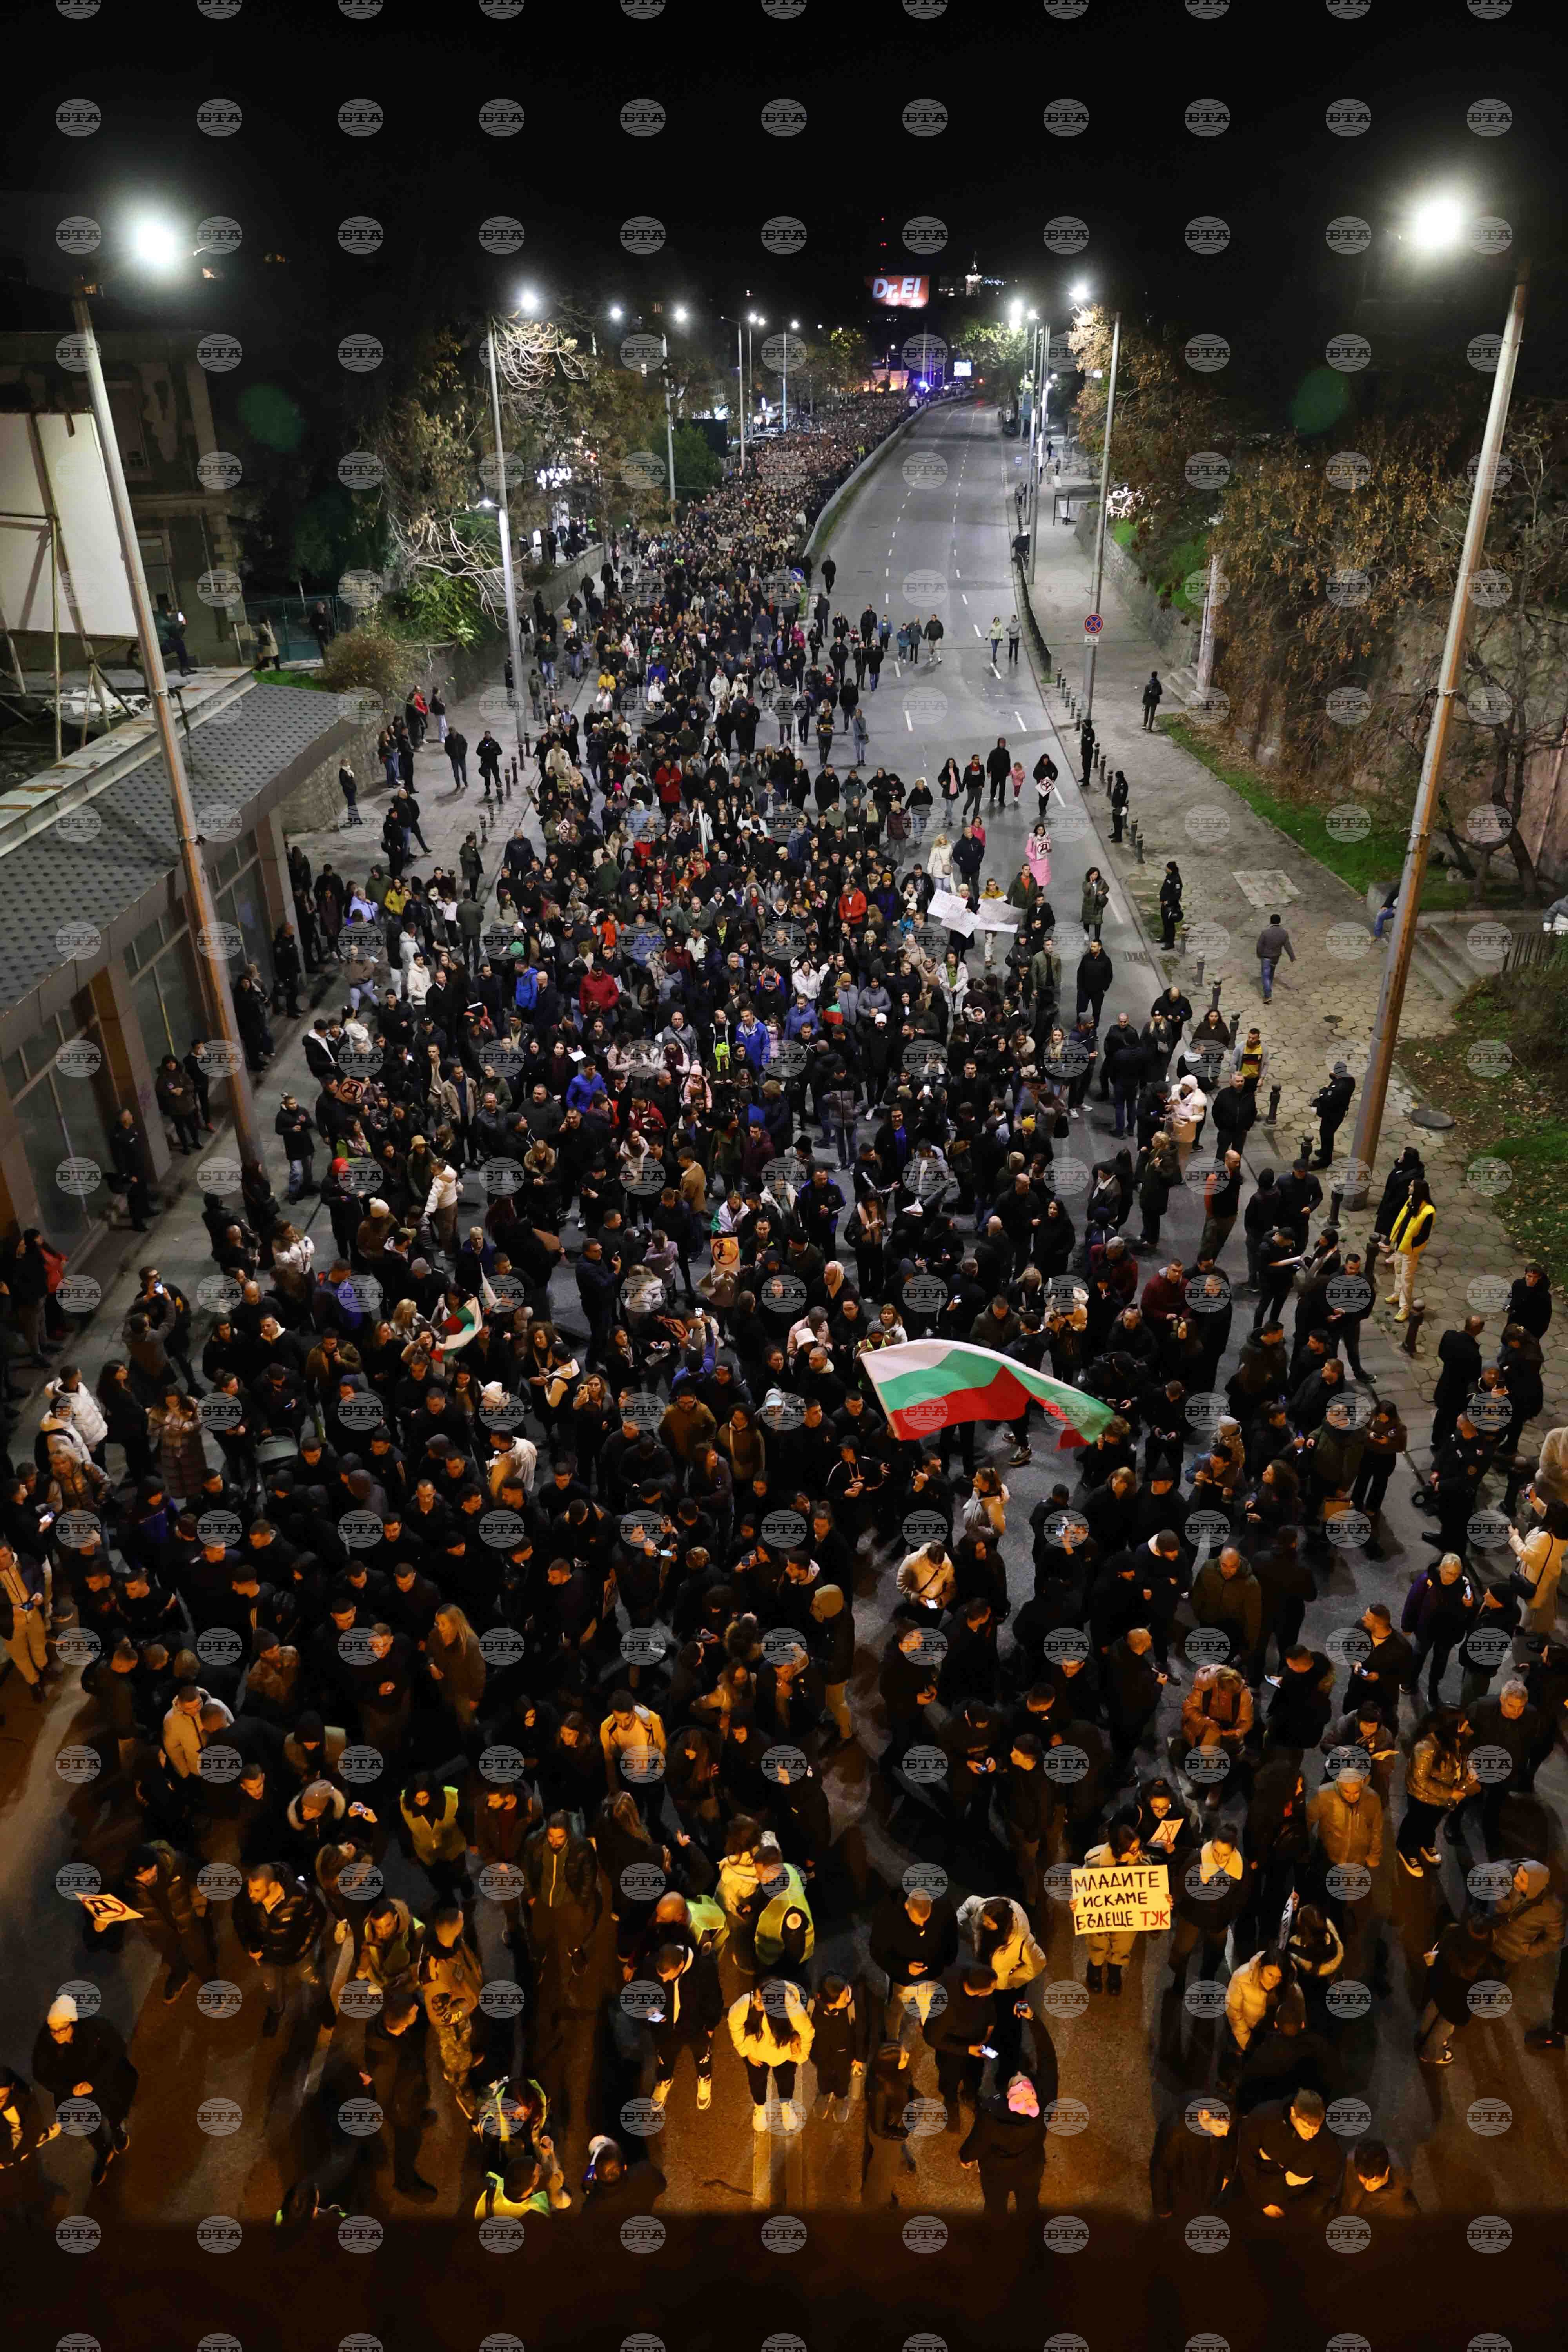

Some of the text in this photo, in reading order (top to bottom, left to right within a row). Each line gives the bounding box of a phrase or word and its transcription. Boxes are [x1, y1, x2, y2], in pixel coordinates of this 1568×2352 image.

[1075, 1871, 1160, 1893] МЛАДИТЕ
[1083, 1892, 1147, 1908] ИСКАМЕ
[1076, 1910, 1169, 1930] БЪДЕЩЕ ТУК
